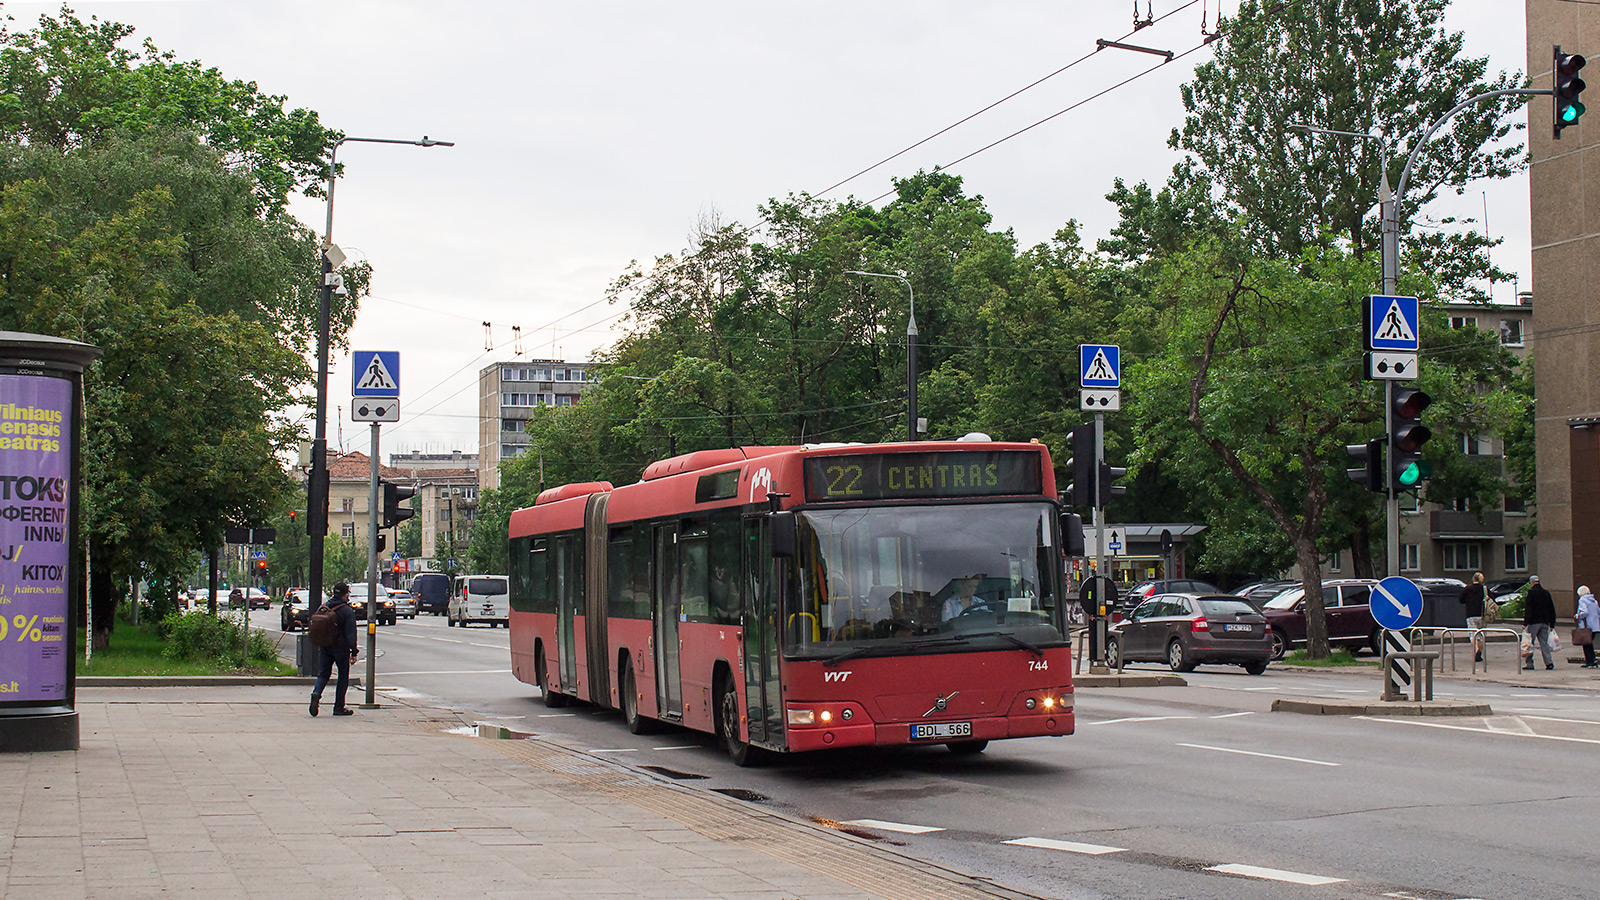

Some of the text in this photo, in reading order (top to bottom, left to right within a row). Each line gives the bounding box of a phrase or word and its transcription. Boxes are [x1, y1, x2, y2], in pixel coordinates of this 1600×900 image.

[18, 358, 46, 366] JCDecaux
[0, 421, 61, 437] enasis
[0, 435, 60, 452] eatras
[826, 463, 998, 496] 22 CENTRAS
[13, 614, 42, 642] %
[1028, 660, 1049, 671] 744
[823, 671, 852, 682] VVT
[918, 725, 942, 737] BDL
[948, 723, 970, 735] 566
